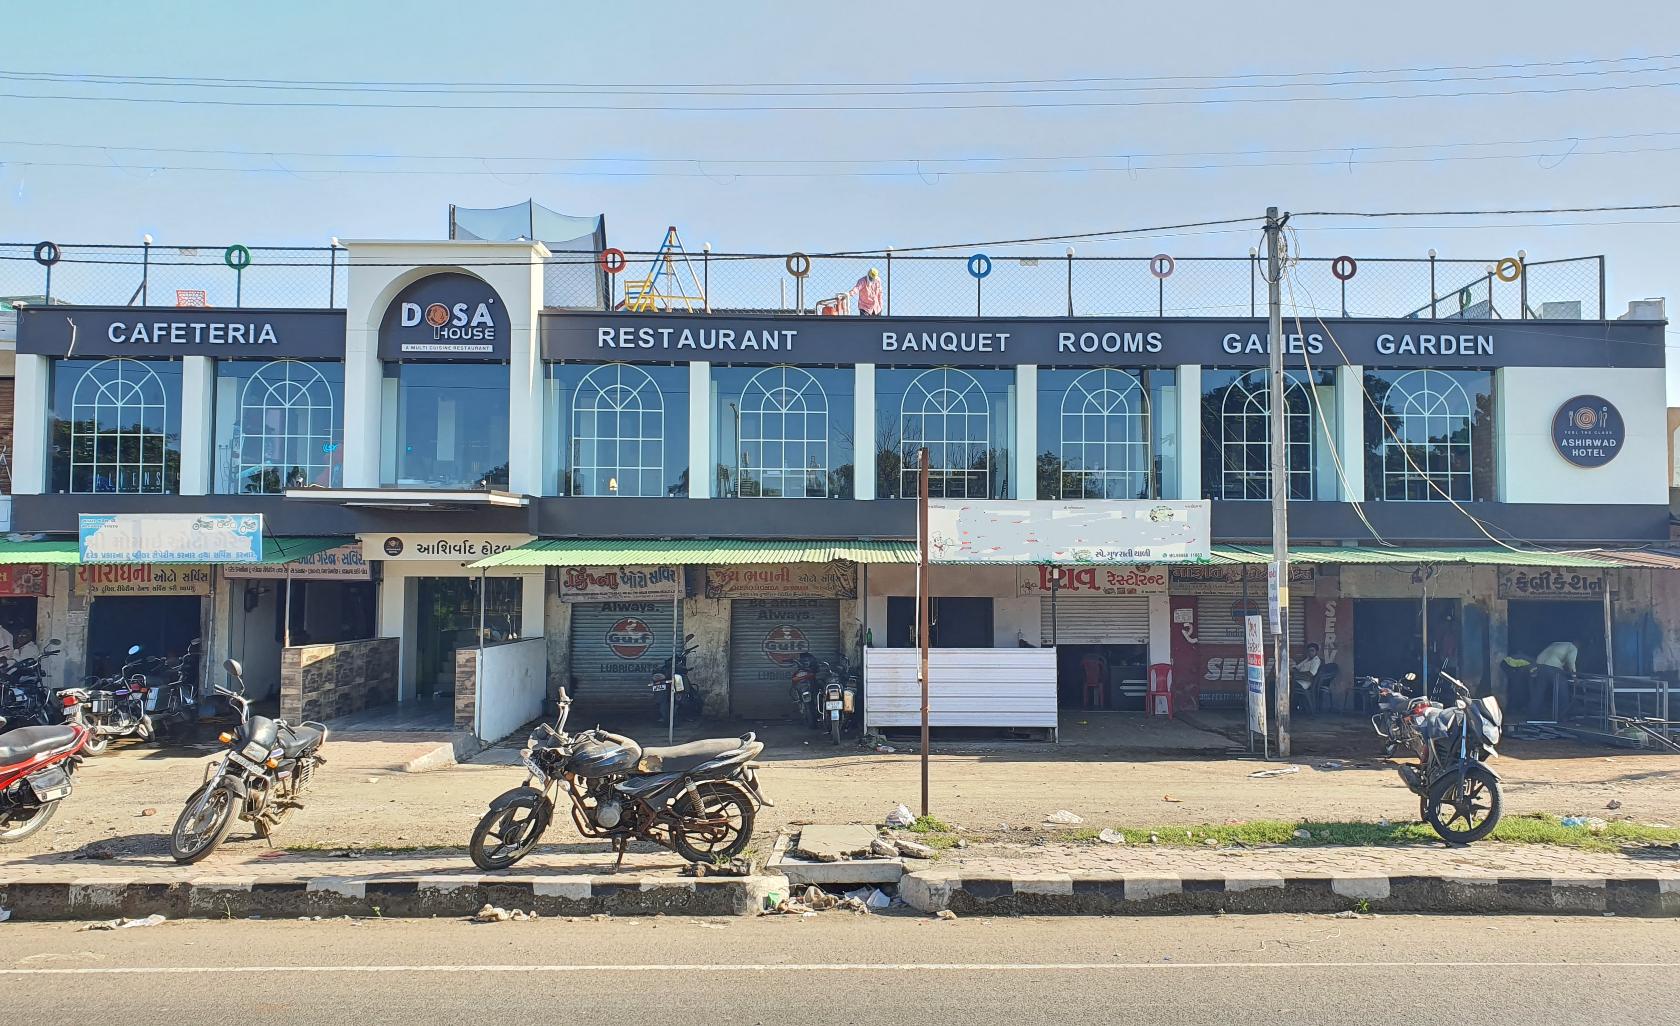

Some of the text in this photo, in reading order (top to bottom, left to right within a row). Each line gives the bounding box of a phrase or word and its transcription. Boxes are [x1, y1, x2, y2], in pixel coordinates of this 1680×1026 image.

[401, 302, 495, 328] DOSA
[107, 321, 279, 345] CAFETERIA
[434, 327, 495, 340] HOUSE
[598, 327, 798, 351] RESTAURANT
[882, 332, 1010, 352] BANQUET
[1058, 332, 1163, 353] ROOMS
[1376, 334, 1495, 355] GARDEN
[1561, 439, 1617, 447] ASHIRWAD
[1572, 448, 1606, 457] HOTEL
